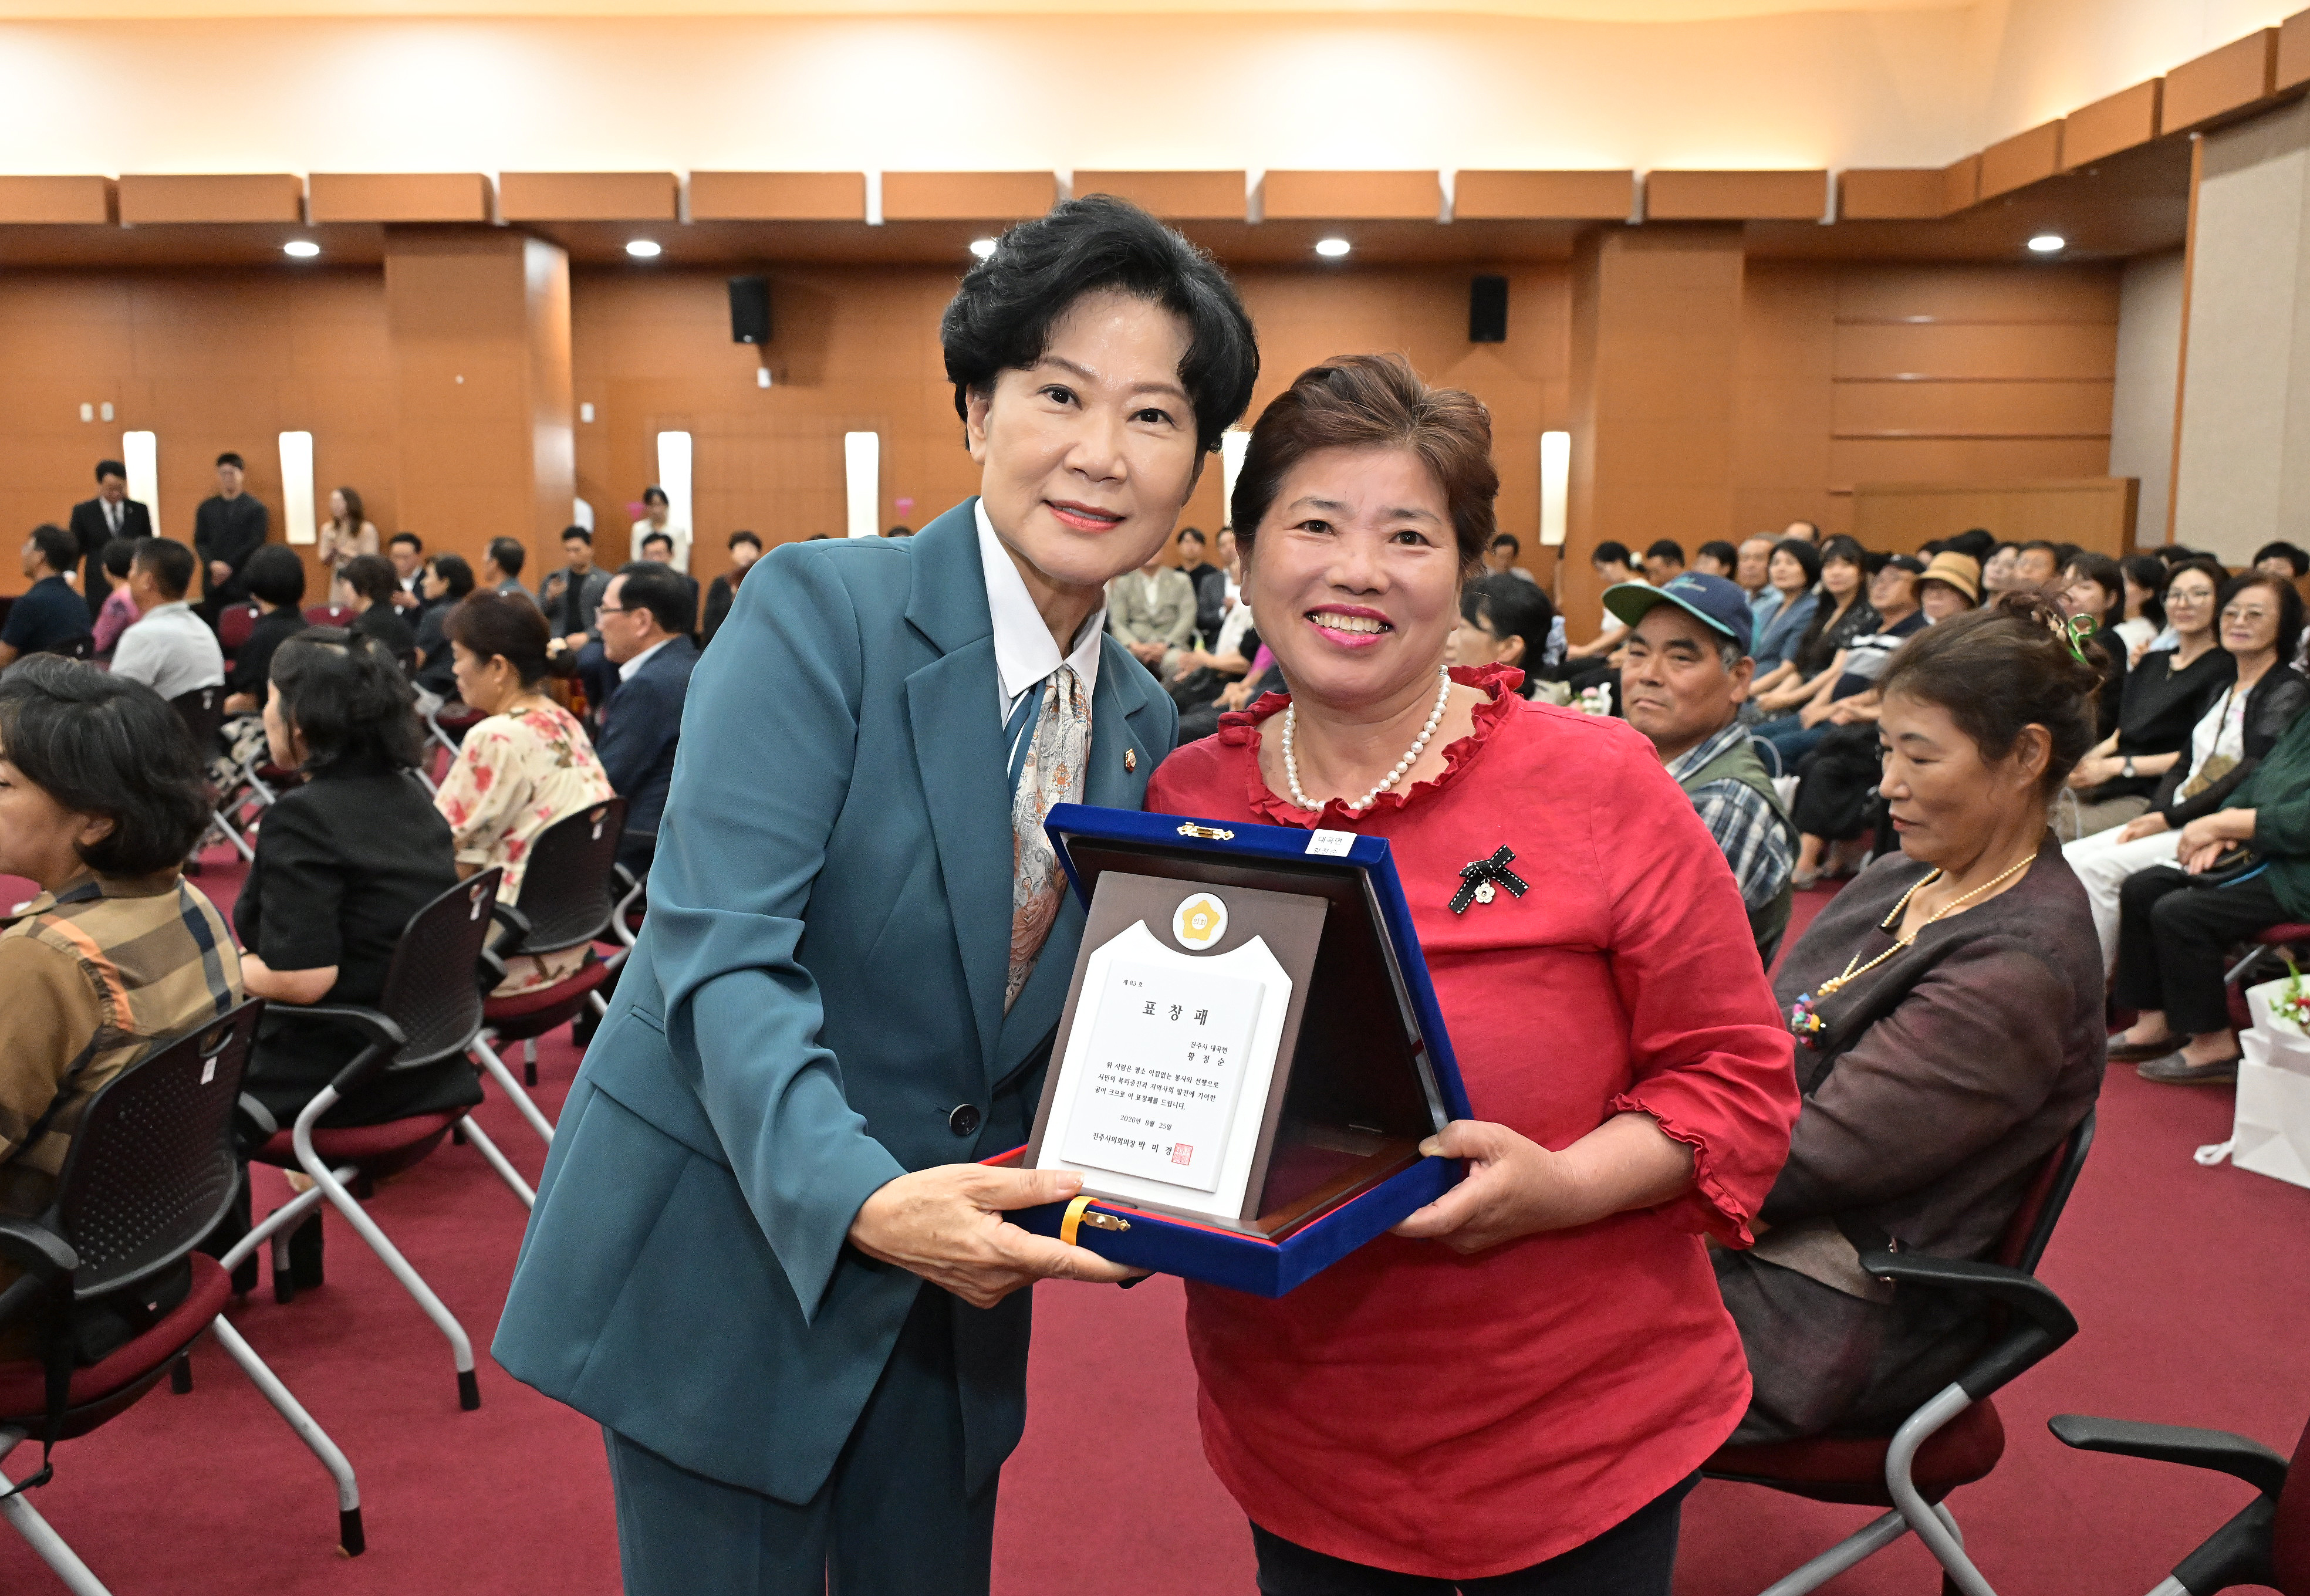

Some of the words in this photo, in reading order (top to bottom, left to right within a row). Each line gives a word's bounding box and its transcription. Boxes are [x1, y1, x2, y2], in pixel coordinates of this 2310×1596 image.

[1318, 836, 1342, 845] 대곡면
[1193, 918, 1206, 926] 의회
[1190, 1042, 1208, 1051] 진주시
[1210, 1044, 1228, 1054] 대곡면
[1115, 1063, 1132, 1073] 사람은
[1135, 1067, 1146, 1075] 평소
[1149, 1070, 1172, 1080] 아낌없는
[1175, 1074, 1193, 1084] 봉사와
[1195, 1078, 1219, 1088] 선행으로
[1097, 1073, 1116, 1083] 시민의
[1118, 1077, 1147, 1089] 복리증진과
[1150, 1083, 1174, 1094] 지역사회
[1197, 1092, 1216, 1102] 기여한
[1095, 1086, 1106, 1094] 공이
[1108, 1089, 1125, 1098] 크므로
[1135, 1094, 1159, 1105] 표창패를
[1160, 1099, 1186, 1110] 드립니다.
[1120, 1114, 1141, 1124] 2026년
[1159, 1122, 1172, 1131] 25일
[1093, 1132, 1136, 1148] 진주시의회의장
